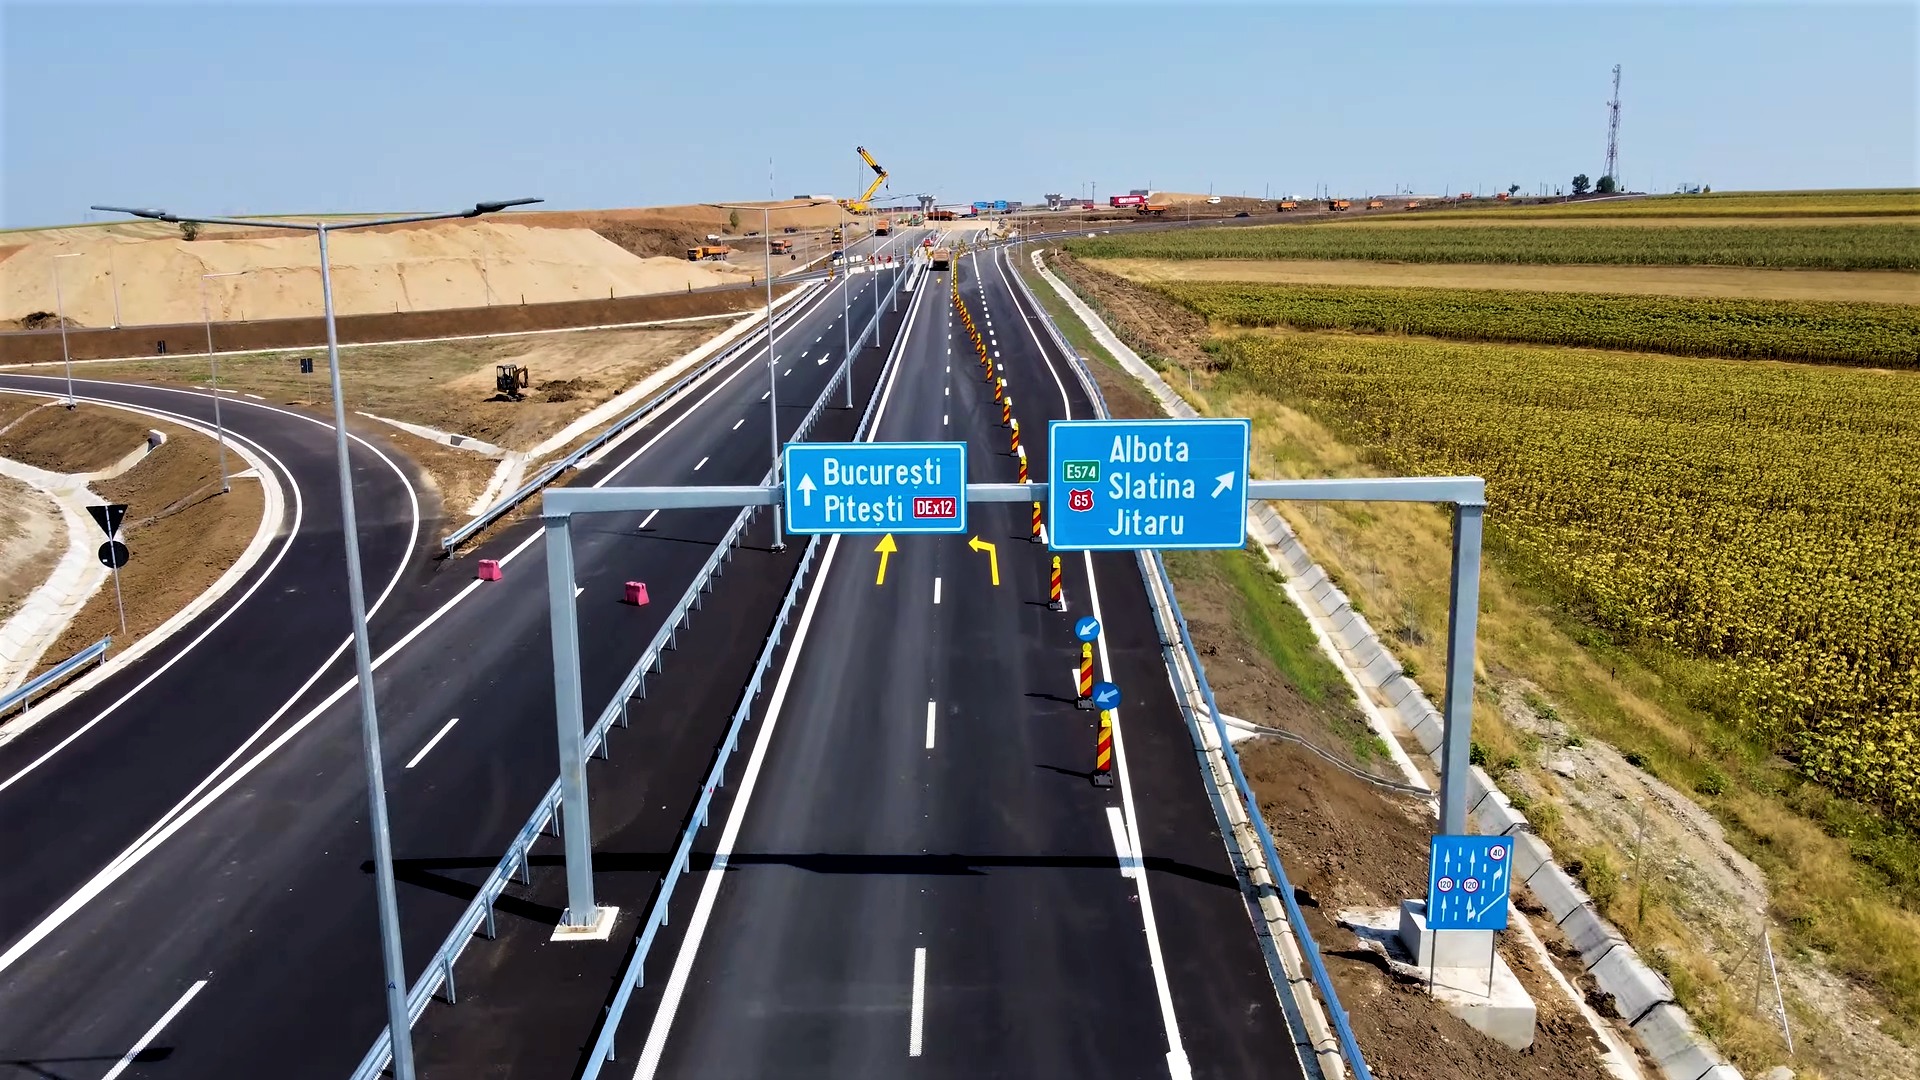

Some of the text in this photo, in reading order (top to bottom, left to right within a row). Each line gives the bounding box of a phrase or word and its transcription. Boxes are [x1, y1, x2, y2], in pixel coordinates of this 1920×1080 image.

[1108, 435, 1189, 463] Albota
[823, 457, 942, 489] București
[1067, 464, 1097, 479] E574
[1108, 472, 1196, 499] Slatina
[823, 494, 953, 526] Pitești DEx12
[1074, 494, 1089, 507] 65
[1108, 508, 1184, 536] Jitaru
[1492, 849, 1502, 857] 40
[1440, 880, 1452, 889] 120
[1465, 881, 1477, 889] 120
